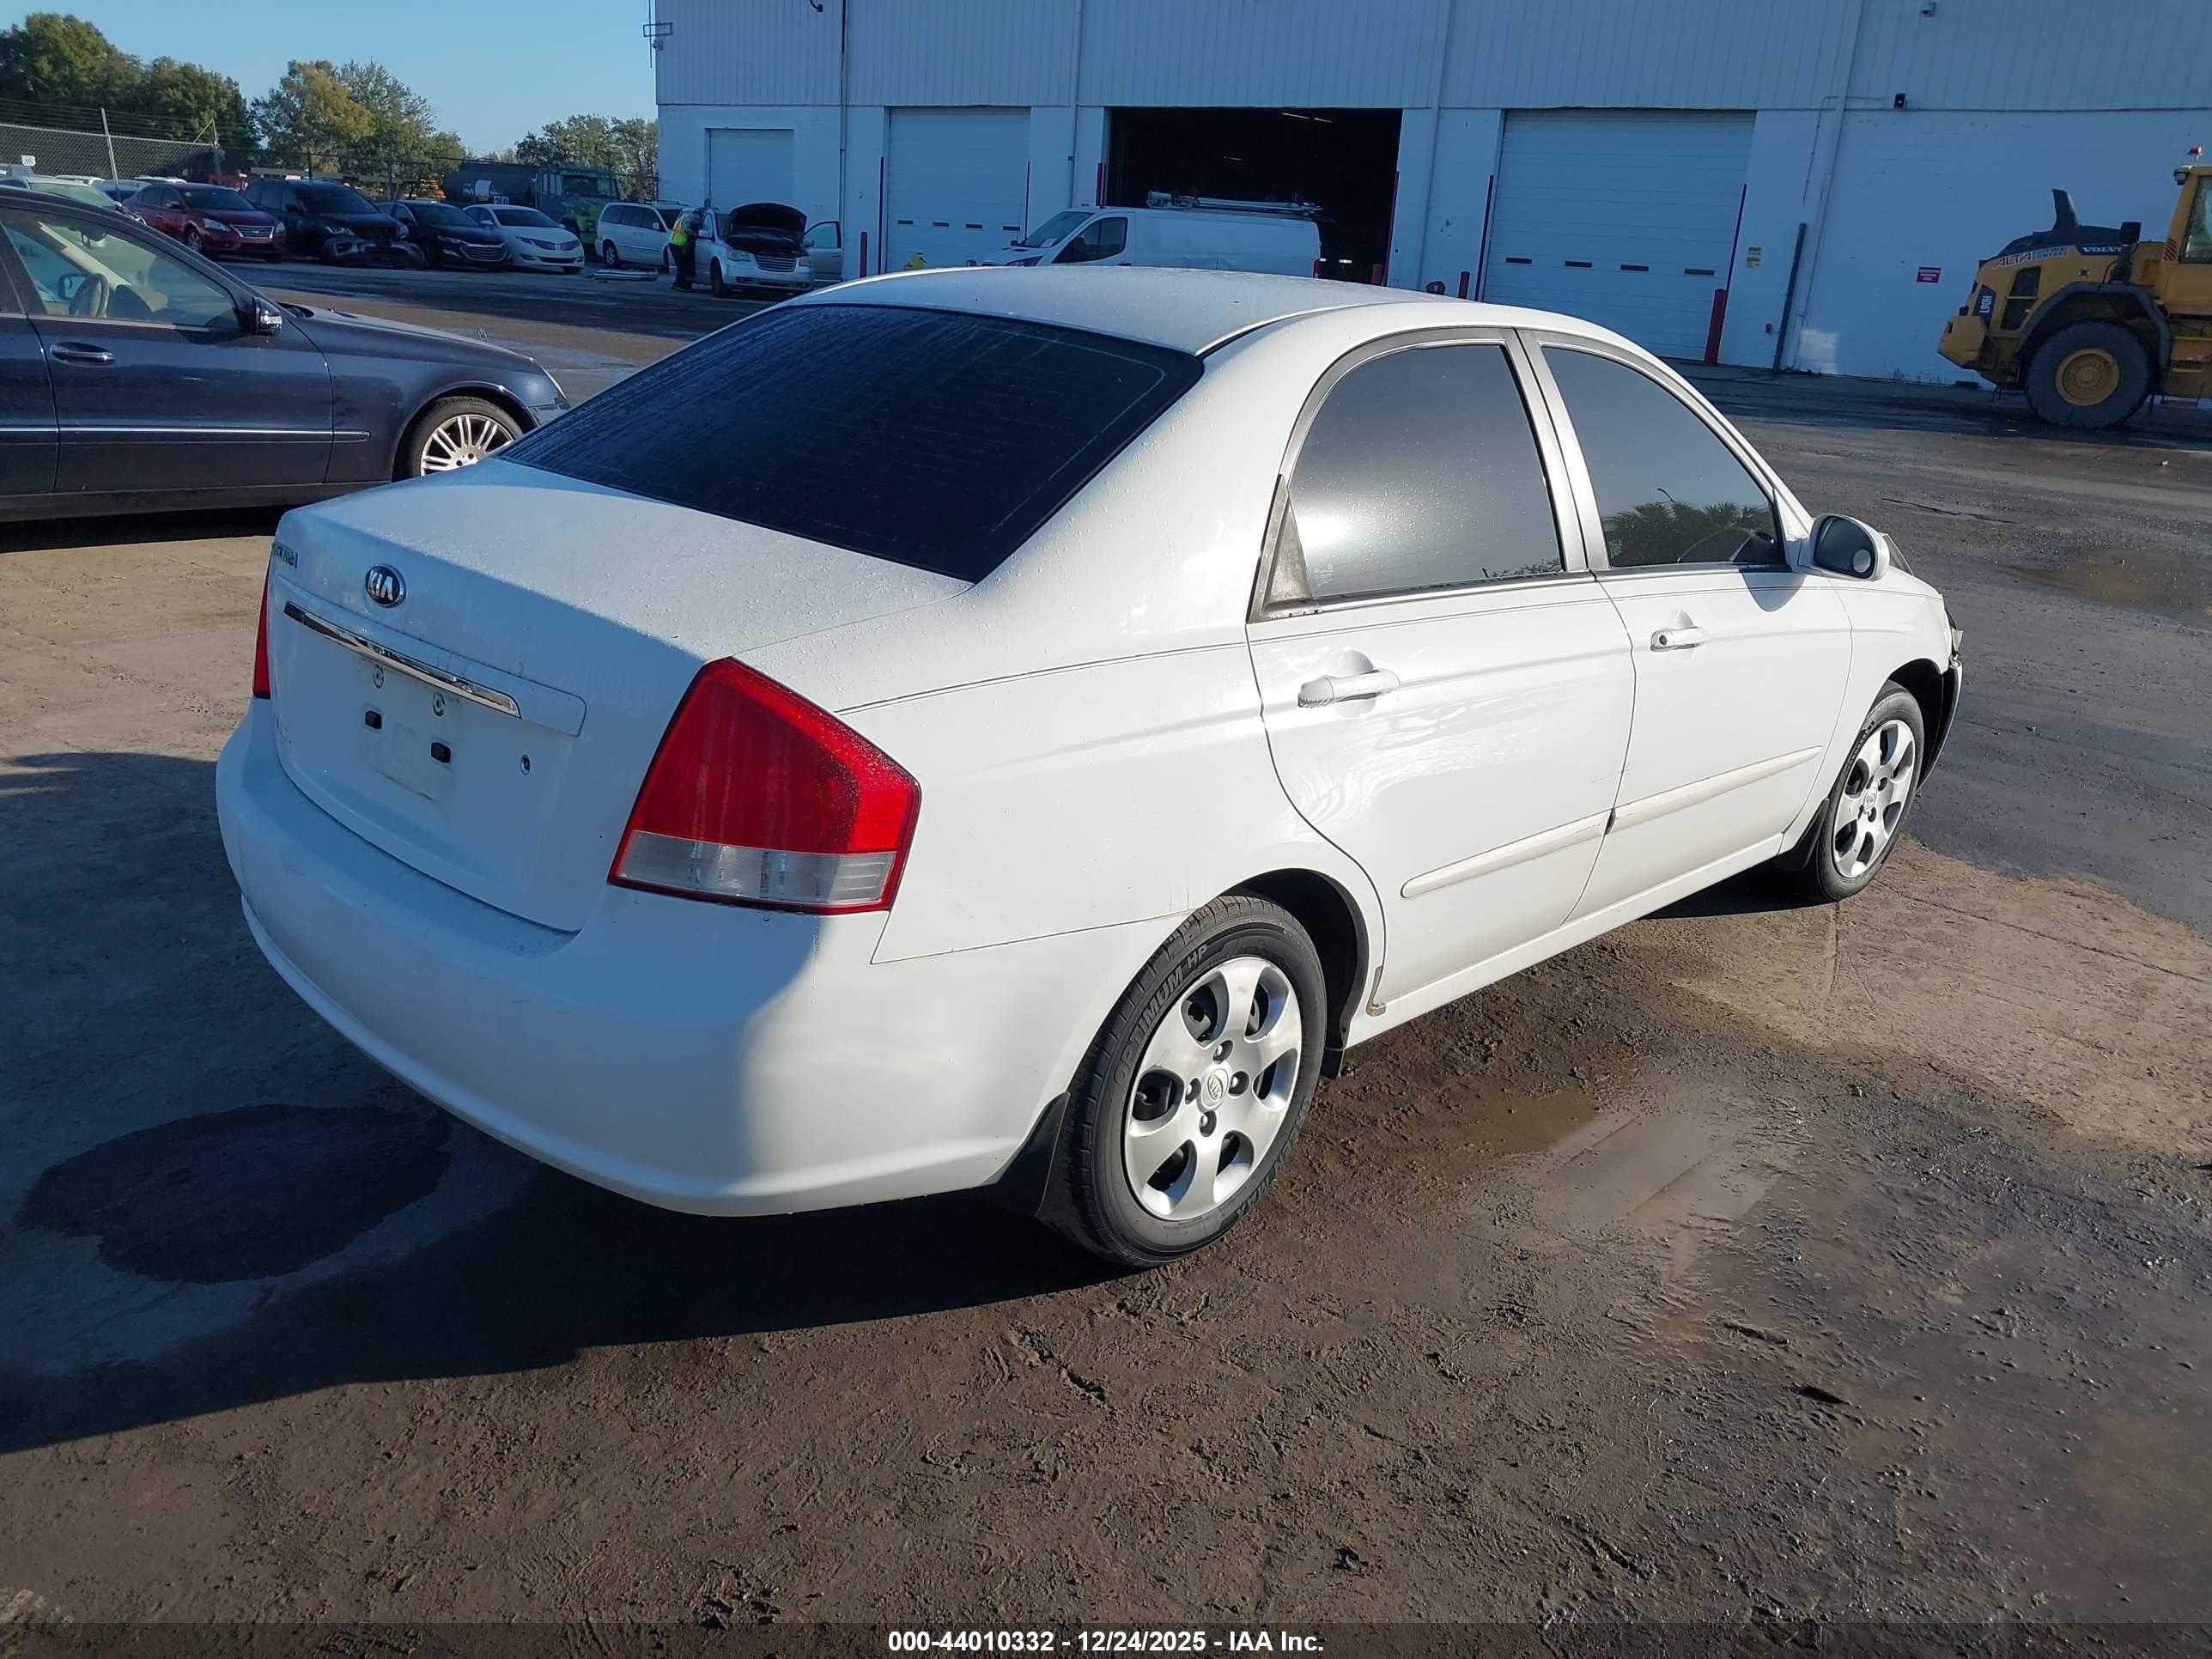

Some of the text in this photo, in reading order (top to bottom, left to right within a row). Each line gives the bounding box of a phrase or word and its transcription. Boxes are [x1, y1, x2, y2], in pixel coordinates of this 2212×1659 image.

[1992, 252, 2033, 270] ALTA
[368, 569, 393, 601] KIA
[1114, 944, 1207, 1085] OPTIMUM HP
